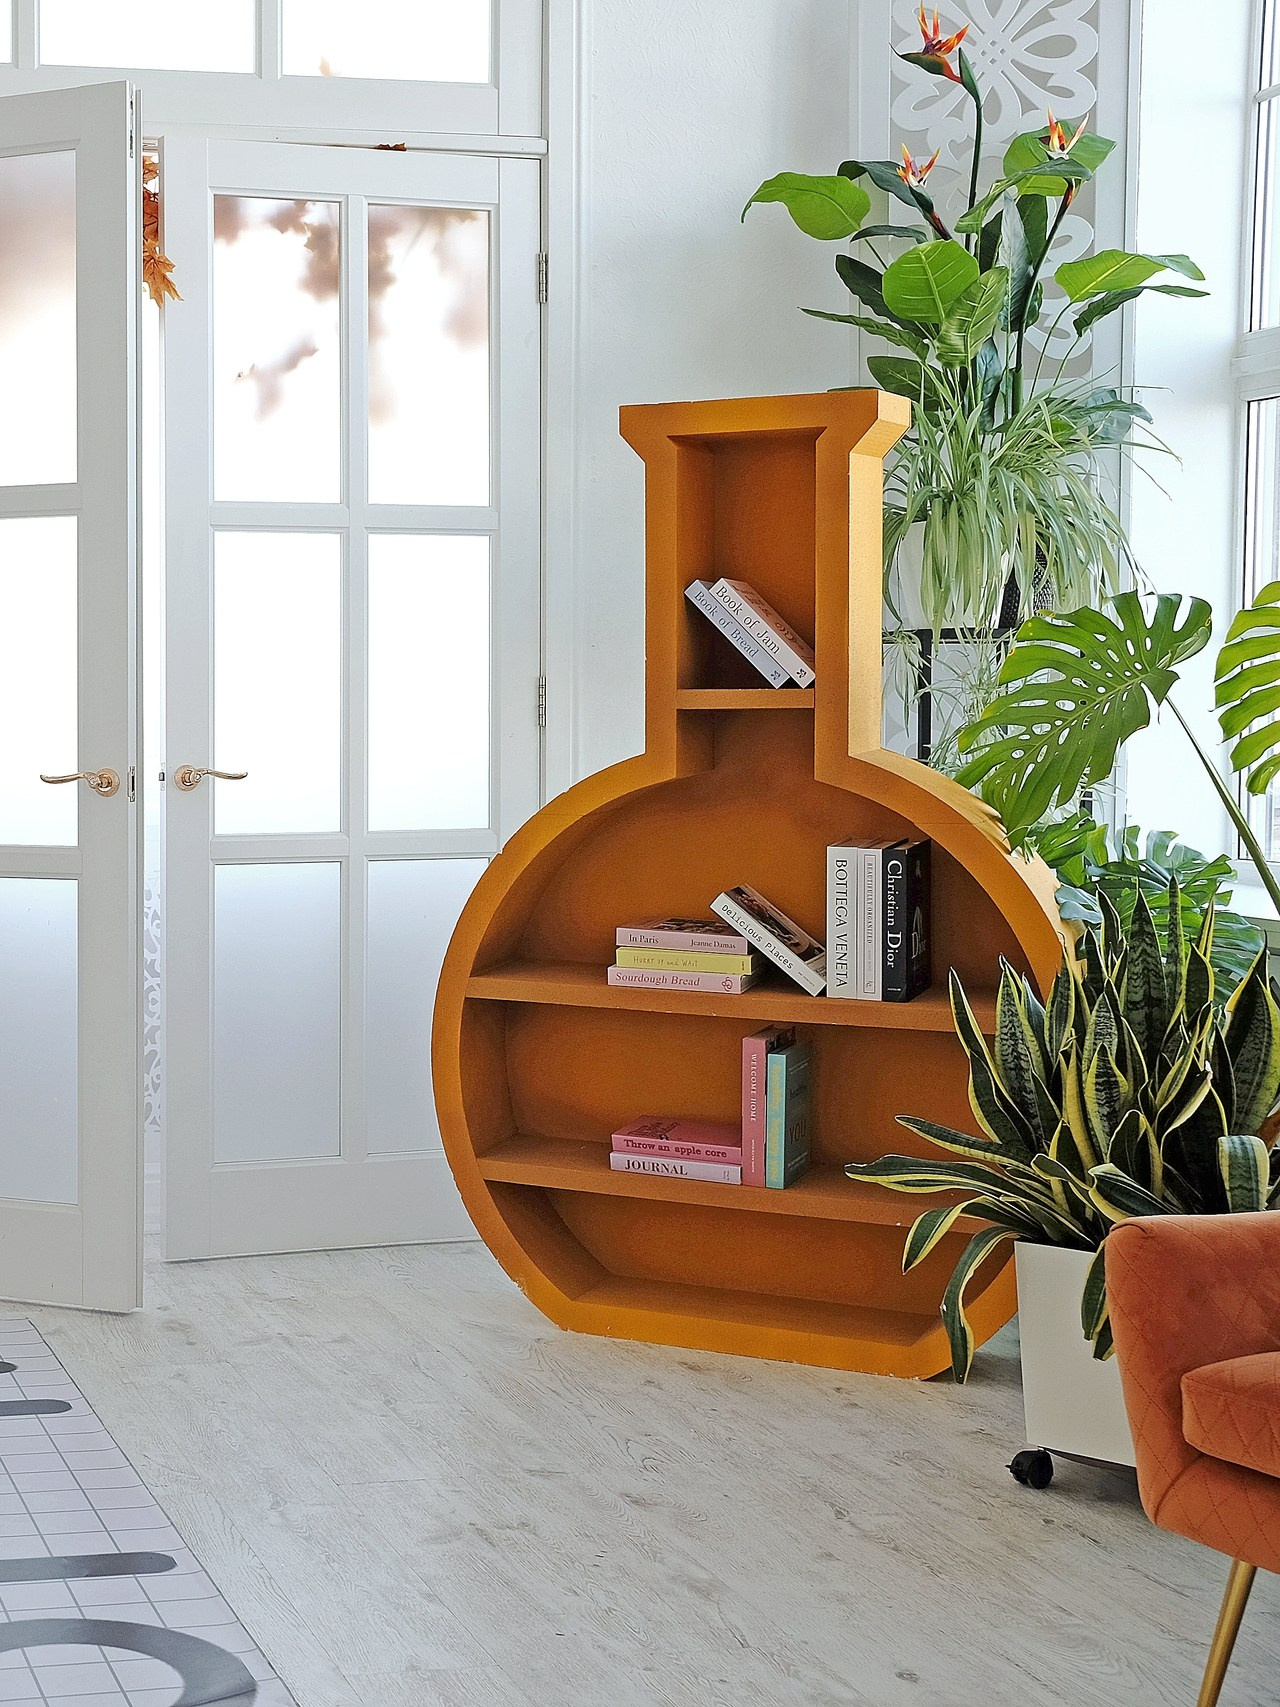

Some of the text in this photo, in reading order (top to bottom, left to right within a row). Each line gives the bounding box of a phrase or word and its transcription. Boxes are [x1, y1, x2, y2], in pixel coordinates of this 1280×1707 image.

[694, 591, 759, 658] Book of Bread
[716, 585, 780, 654] Book of Jam
[887, 860, 903, 926] Christian
[629, 934, 659, 944] In Paris
[721, 904, 794, 970] Delicious Places
[835, 859, 848, 988] BOTTEGA VENETA
[690, 939, 736, 949] Jeanne Damas
[886, 930, 902, 968] Dior
[615, 973, 700, 986] Sourdough Bread
[789, 1119, 807, 1145] YOU
[624, 1139, 656, 1150] Throw
[674, 1146, 701, 1156] apple
[705, 1150, 727, 1158] core
[625, 1159, 688, 1176] JOURNAL
